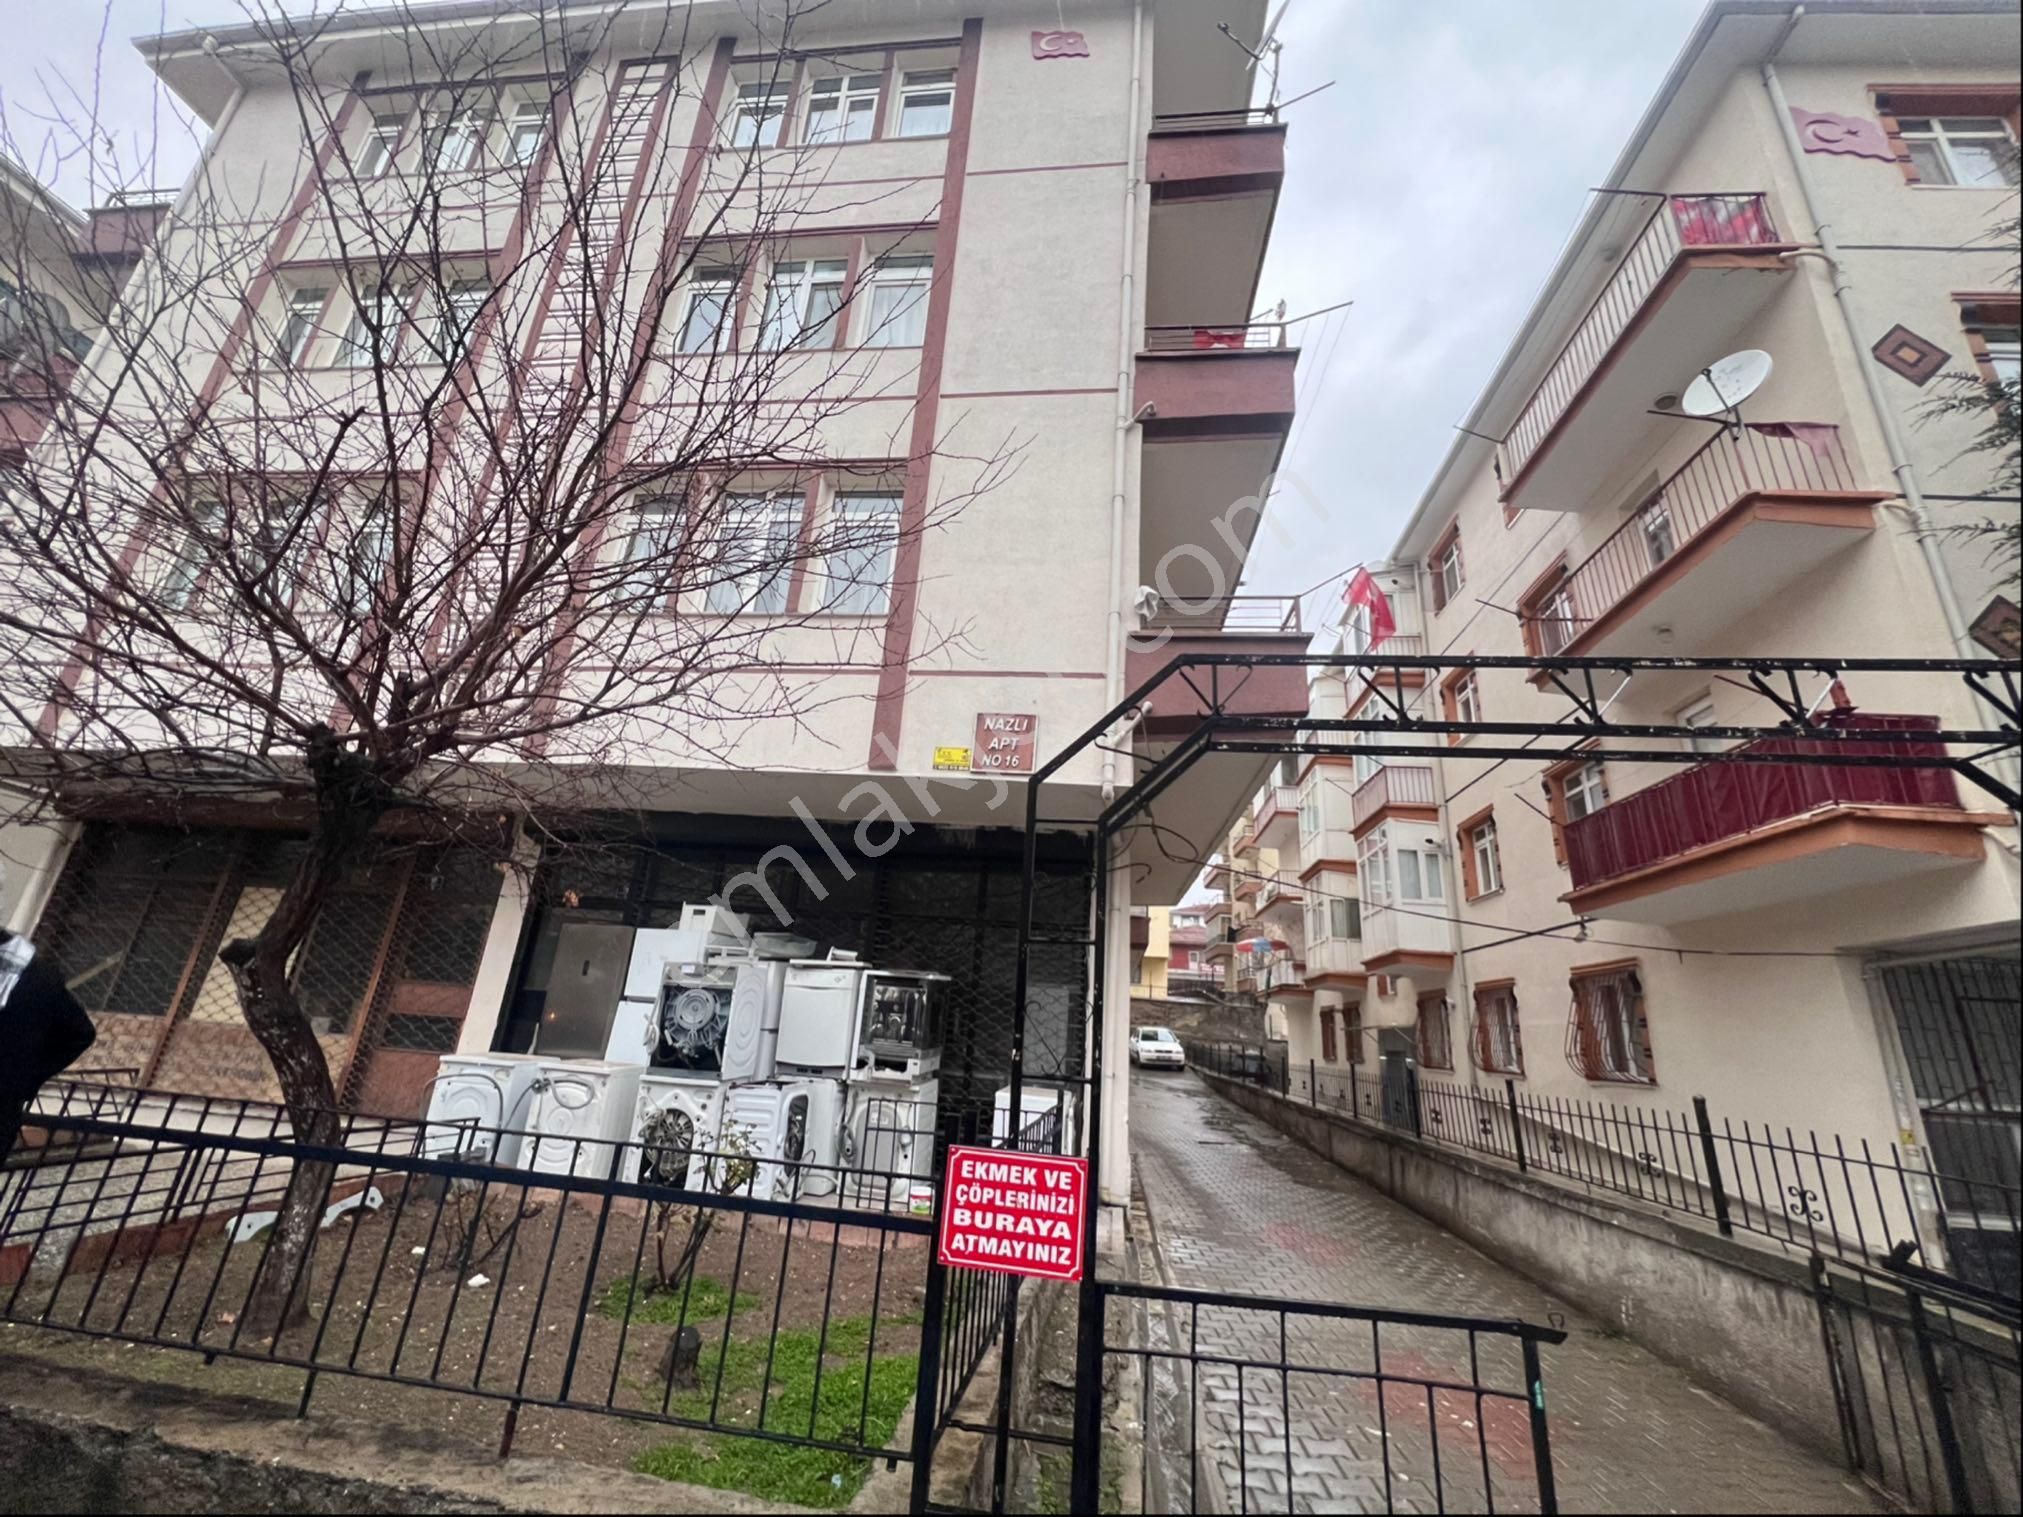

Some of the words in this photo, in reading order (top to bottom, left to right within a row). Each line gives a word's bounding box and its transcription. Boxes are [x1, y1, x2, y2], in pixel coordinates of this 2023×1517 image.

[984, 717, 1029, 732] NAZLI
[988, 737, 1021, 751] APT
[981, 754, 1001, 767] NO
[1004, 755, 1020, 768] 16
[961, 1160, 1038, 1187] EKMEK
[1044, 1168, 1073, 1191] VE
[955, 1182, 1075, 1216] ÇÖPLERİNİZİ
[953, 1207, 1072, 1241] BURAYA
[951, 1232, 1072, 1266] ATMAYINIZ
